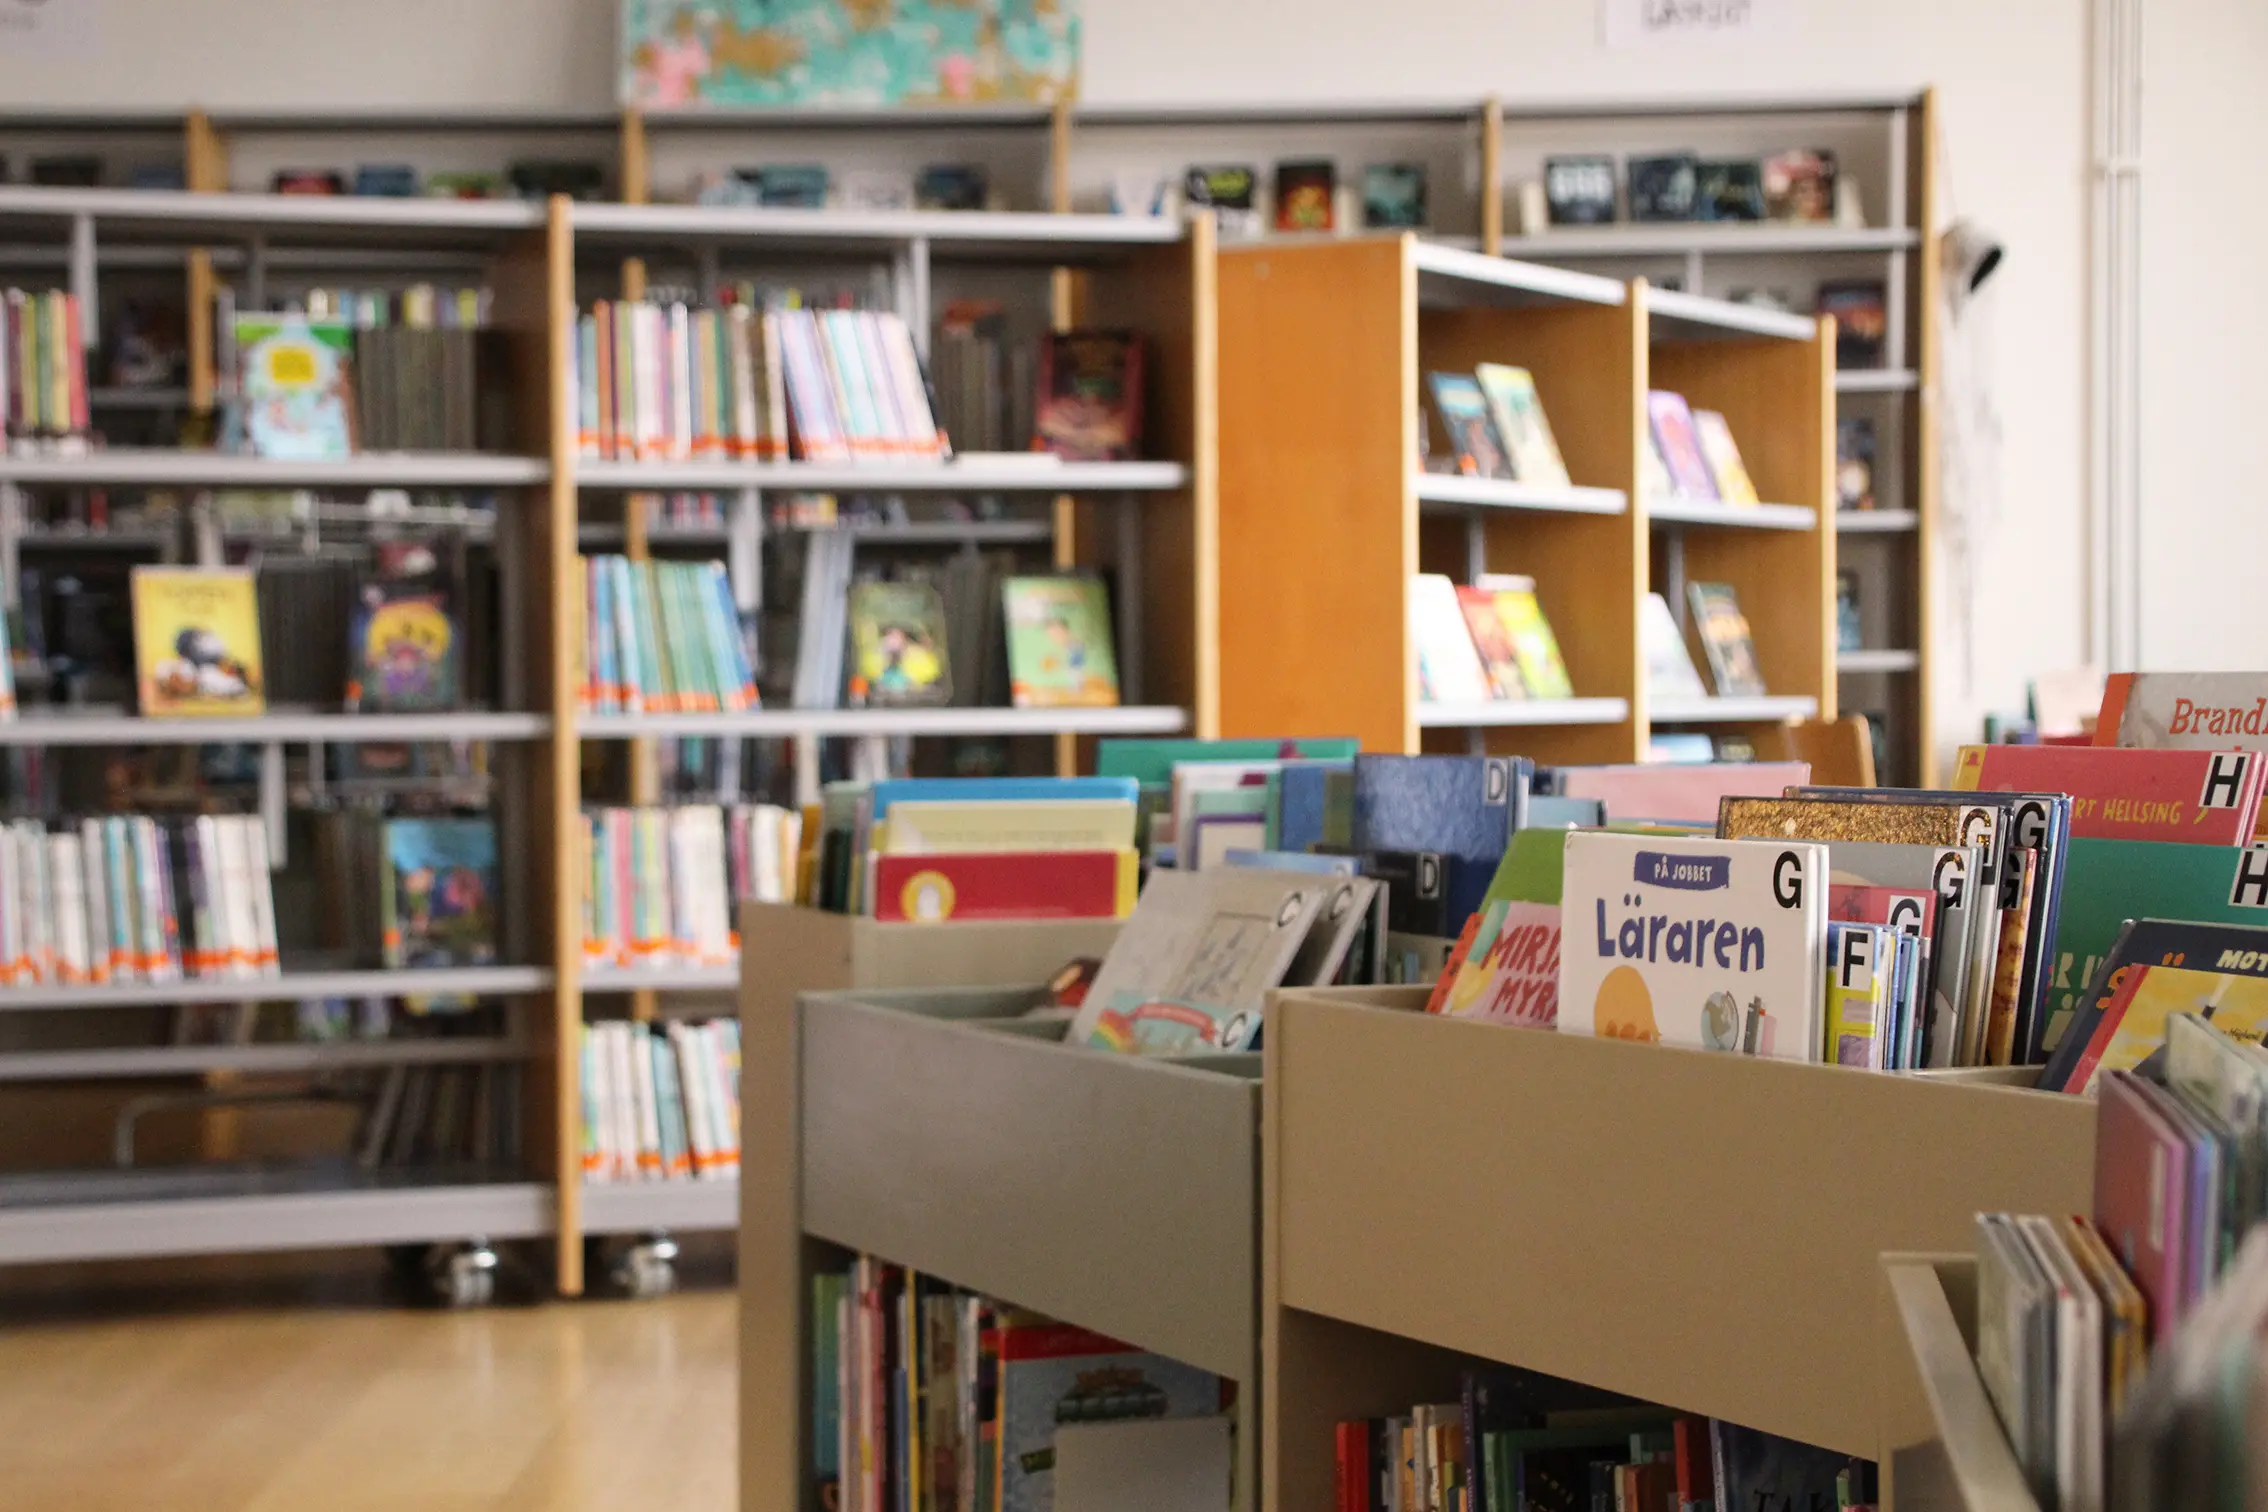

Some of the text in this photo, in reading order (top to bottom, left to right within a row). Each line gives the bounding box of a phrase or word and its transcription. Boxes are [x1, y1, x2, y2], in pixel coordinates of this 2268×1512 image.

[2169, 697, 2268, 735] Brand
[1488, 762, 1506, 800] D
[2203, 755, 2246, 807] H
[2014, 802, 2046, 849] G
[2103, 798, 2184, 825] HELLSING
[1960, 808, 1992, 864] G
[1421, 858, 1438, 894] D
[1654, 855, 1712, 882] PÅ JOBBET
[1773, 851, 1802, 908] G
[1933, 852, 1965, 908] G
[2233, 851, 2268, 905] H
[1277, 893, 1302, 927] C
[1890, 899, 1921, 937] G
[1596, 893, 1765, 972] Läraren
[1843, 931, 1868, 986] F
[1222, 1012, 1247, 1048] C
